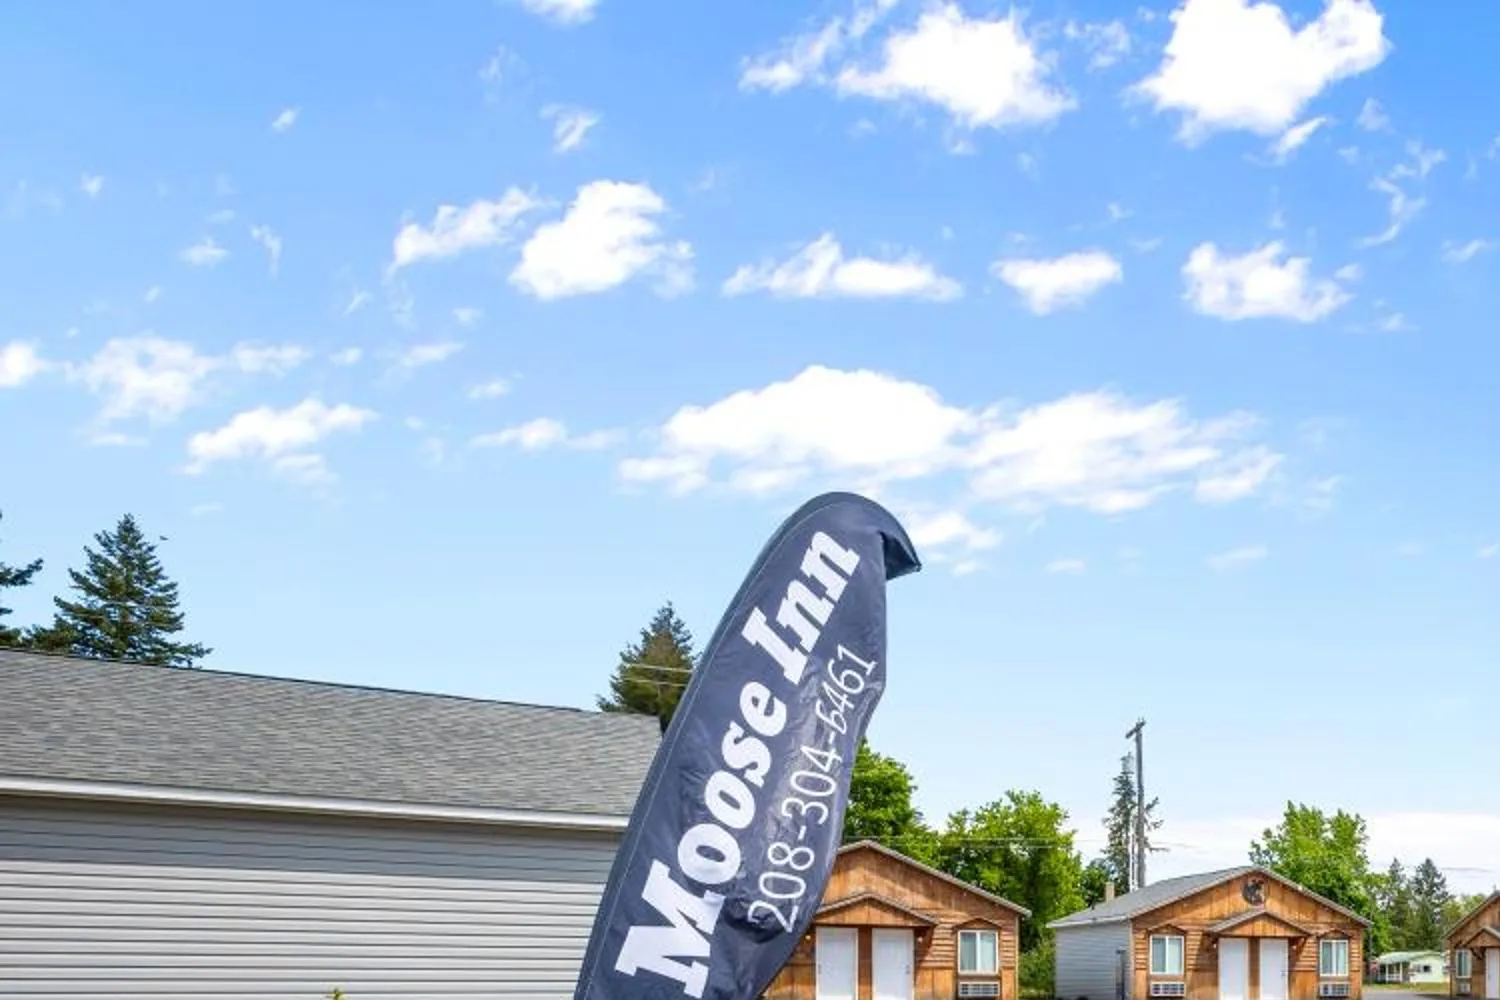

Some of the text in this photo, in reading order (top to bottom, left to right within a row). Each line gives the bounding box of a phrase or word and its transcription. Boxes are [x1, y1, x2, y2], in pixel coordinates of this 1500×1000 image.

[615, 530, 861, 1000] Moose Inn
[747, 644, 878, 933] 208-304-6461
